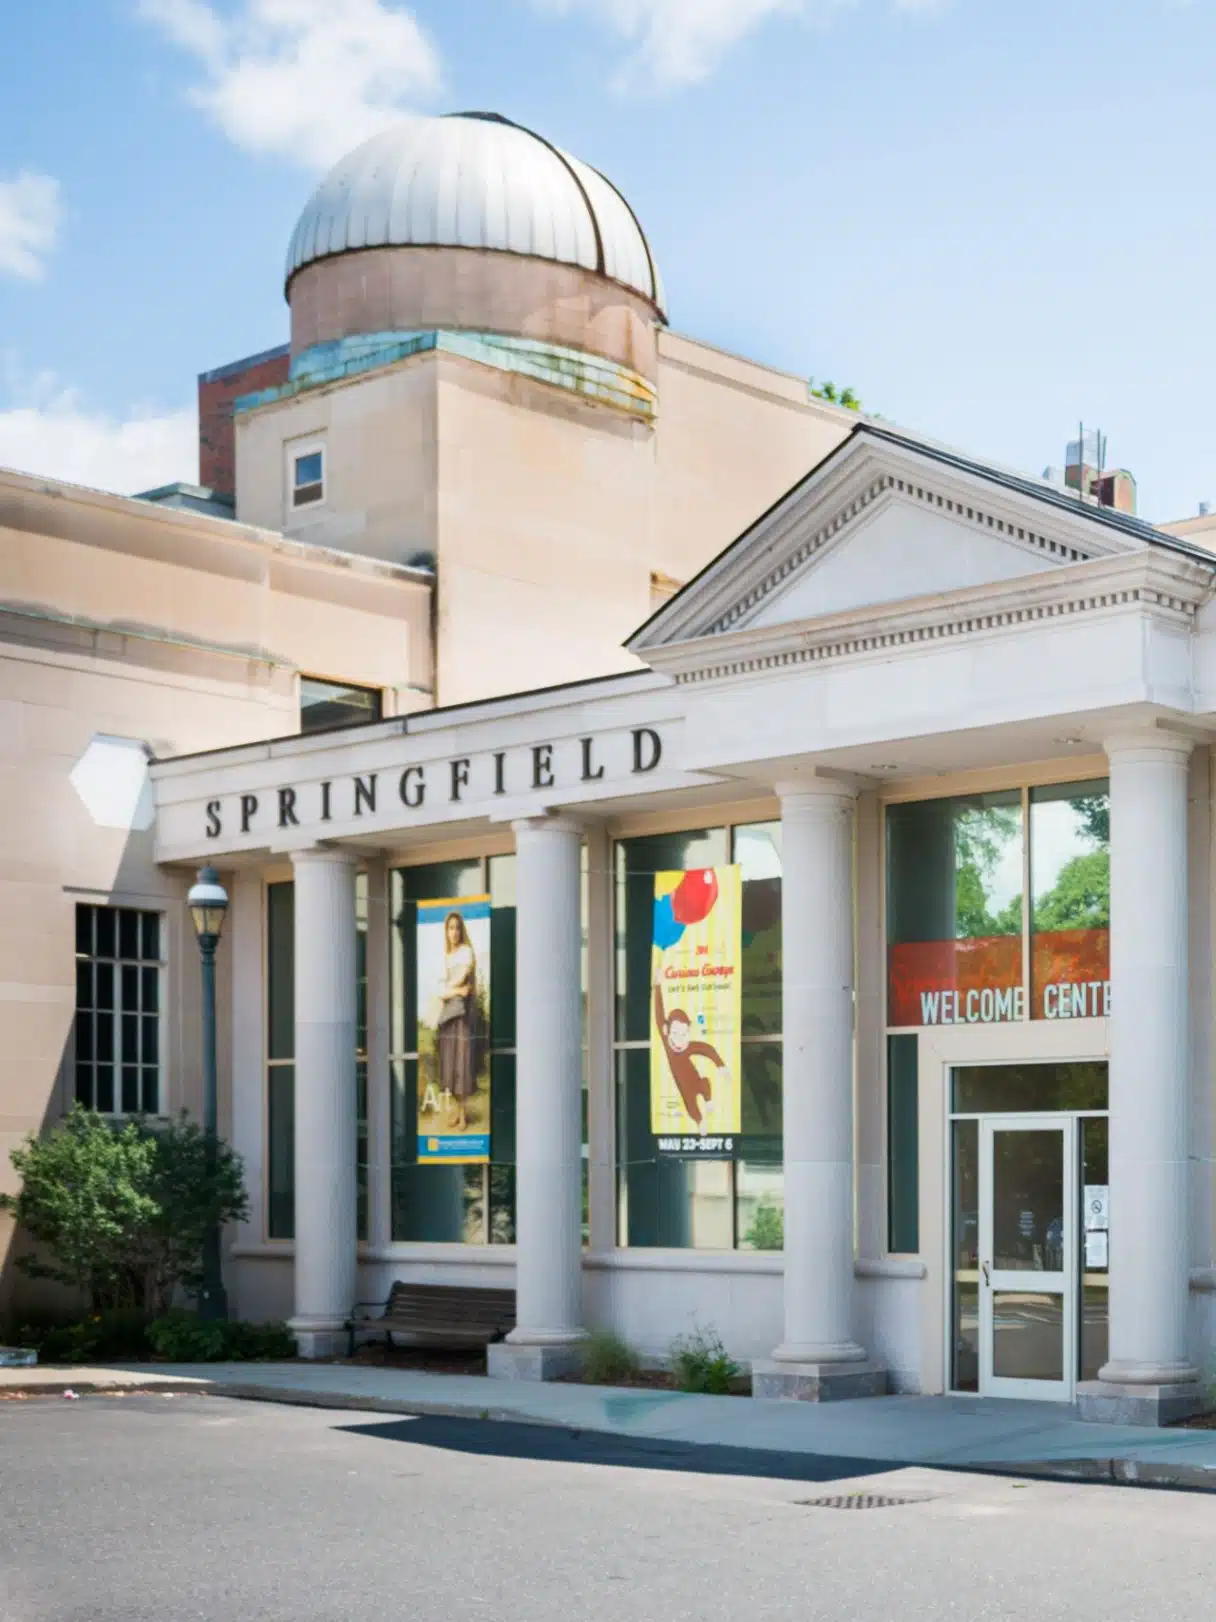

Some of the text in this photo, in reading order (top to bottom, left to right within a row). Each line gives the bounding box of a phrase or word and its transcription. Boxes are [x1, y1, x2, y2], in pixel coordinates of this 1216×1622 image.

[205, 727, 662, 839] SPRINGFIELD
[920, 986, 1024, 1025] WELCOME
[420, 1083, 453, 1113] Art
[658, 1137, 681, 1151] MAY
